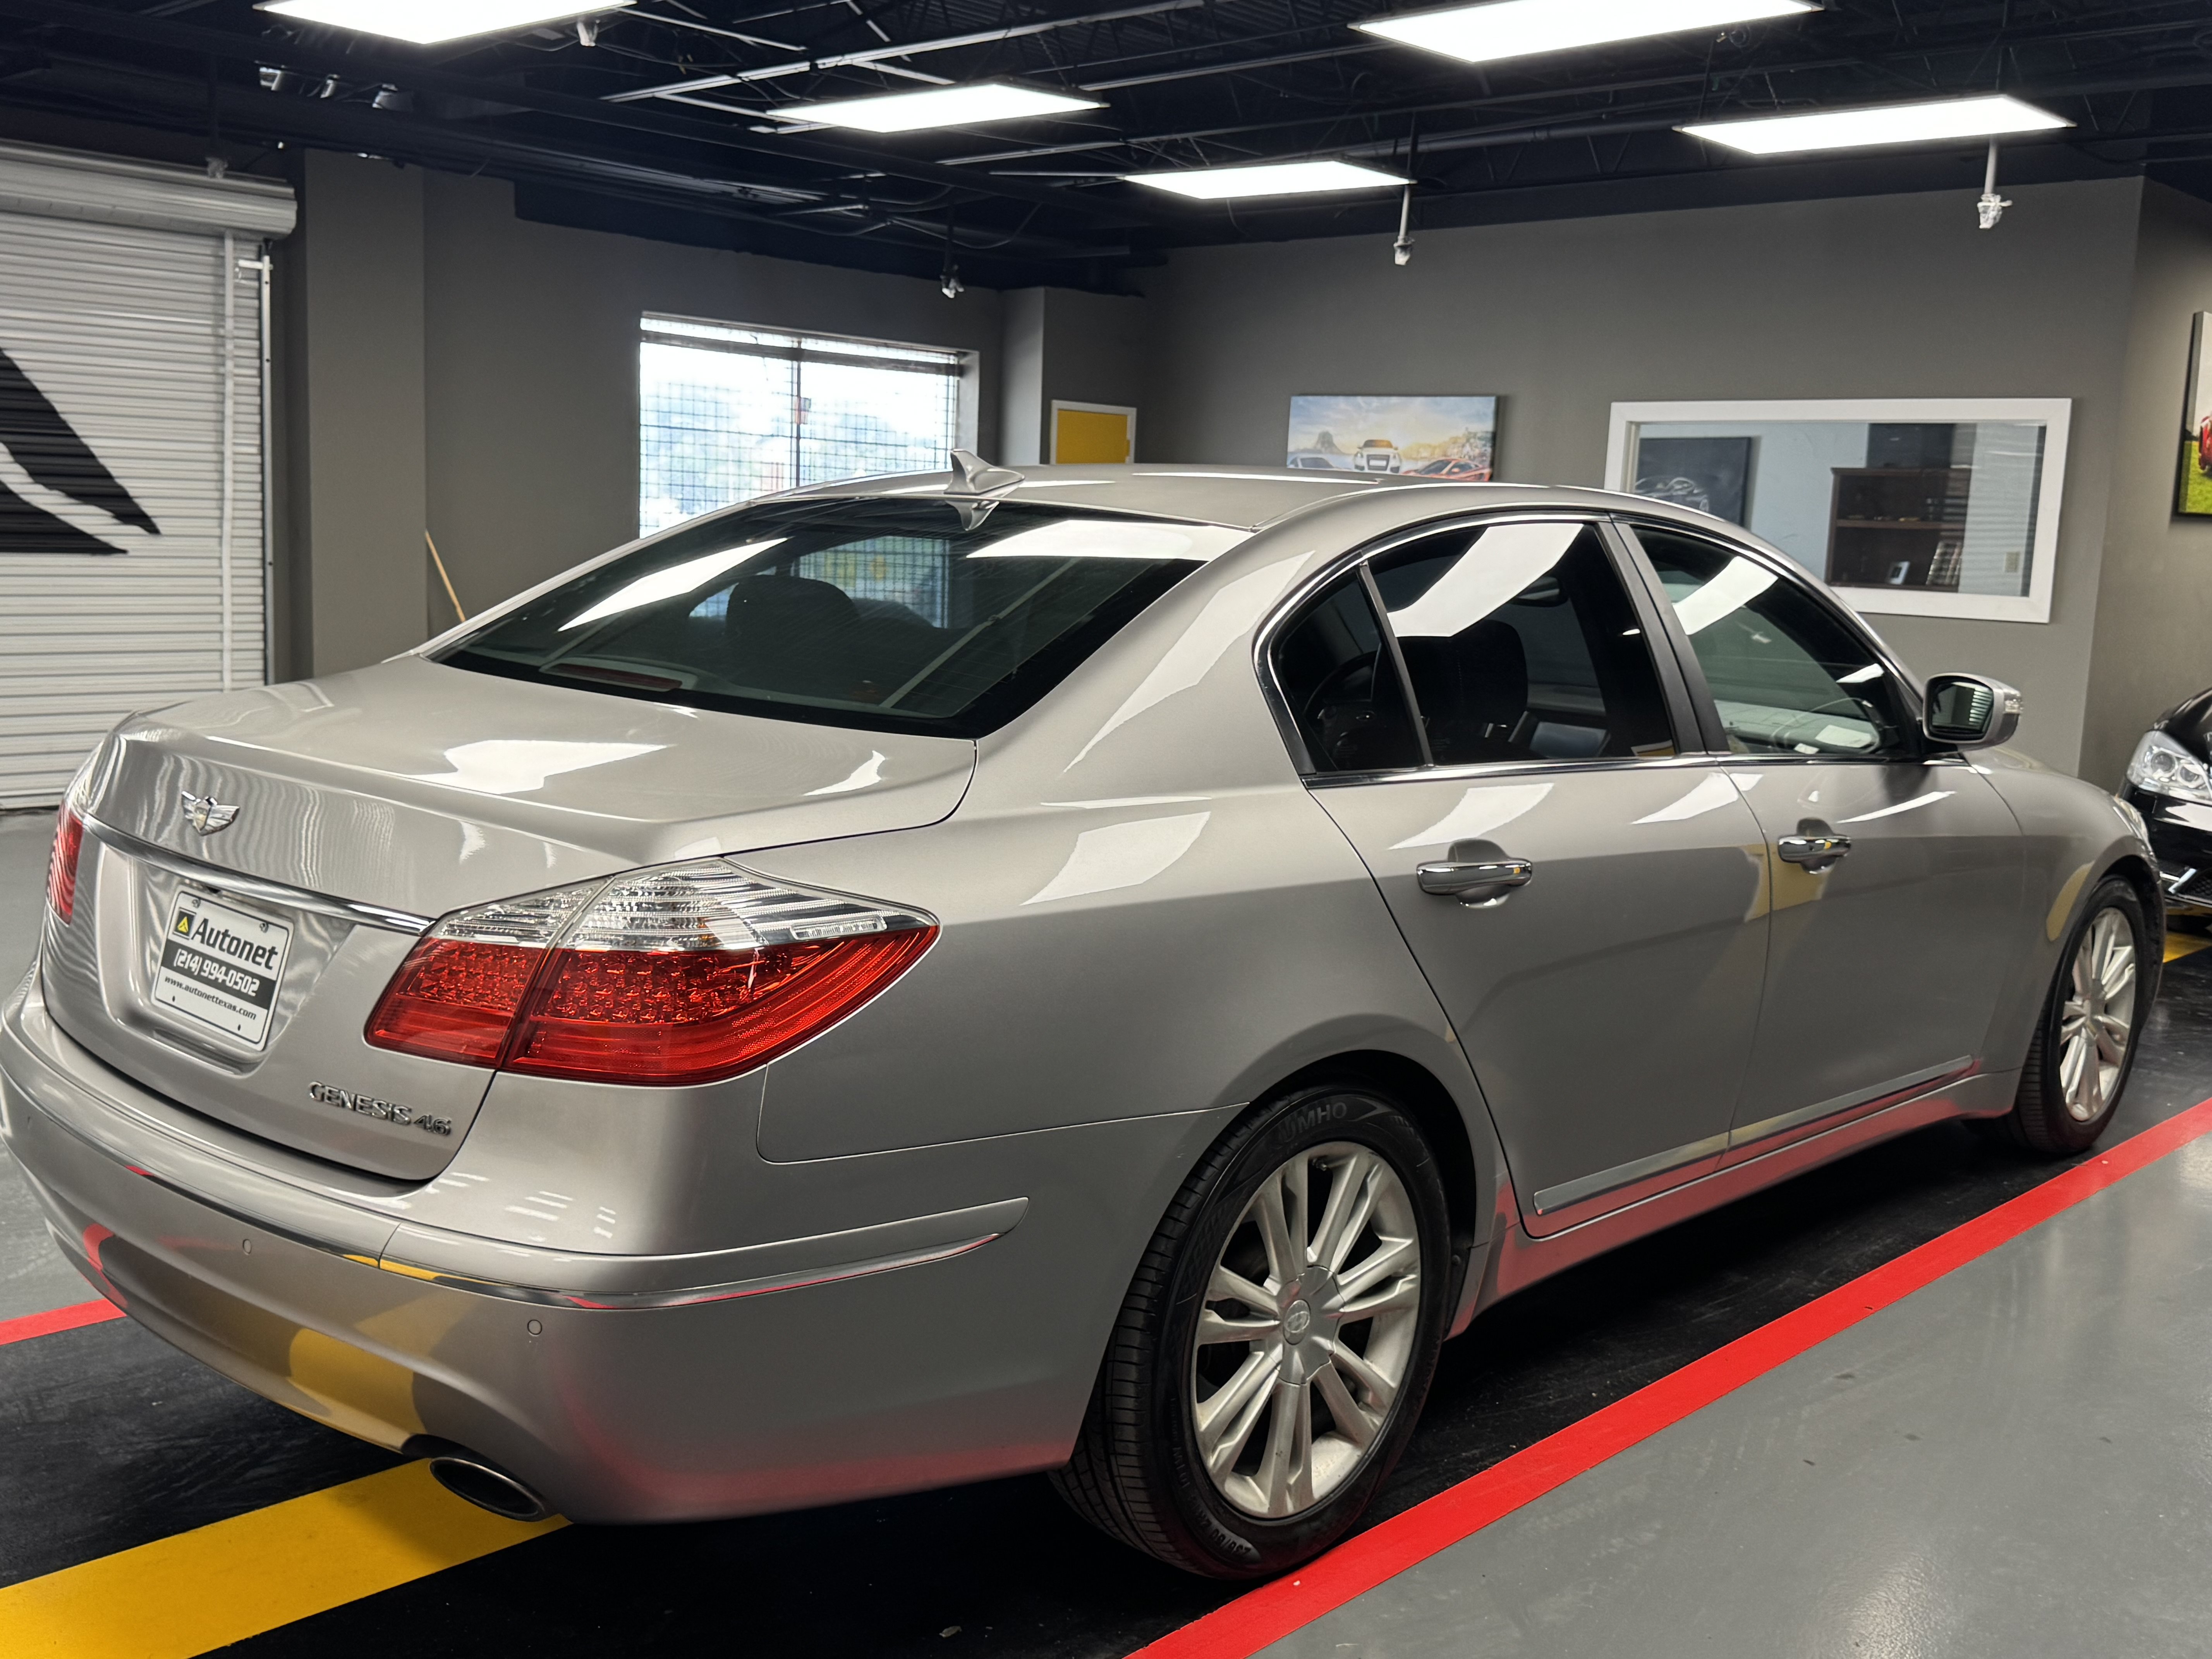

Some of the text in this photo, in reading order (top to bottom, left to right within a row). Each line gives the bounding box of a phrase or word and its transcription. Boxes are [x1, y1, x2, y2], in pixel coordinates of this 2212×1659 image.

[191, 918, 278, 970] Autonet
[173, 949, 260, 997] (214) 994-0502
[165, 976, 257, 1020] www.autonettexas.com
[309, 1081, 412, 1125] GENESIS
[1272, 1102, 1347, 1148] UMHO
